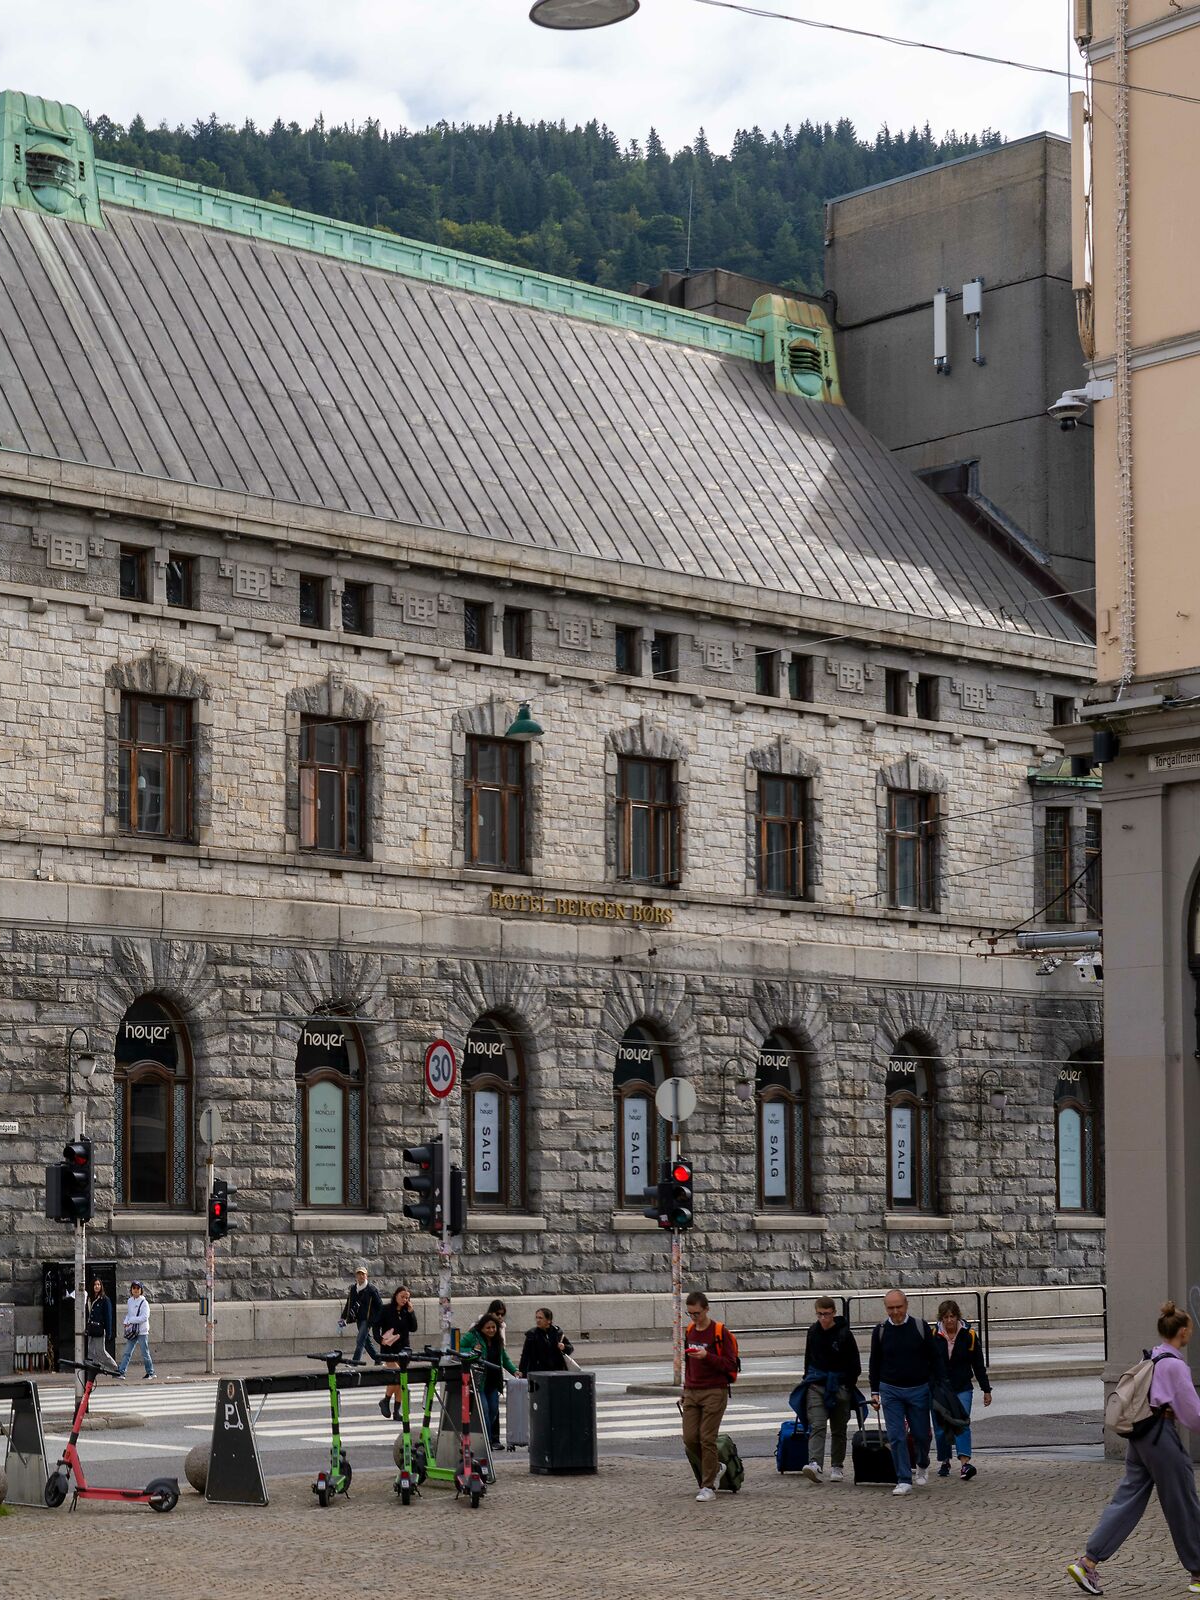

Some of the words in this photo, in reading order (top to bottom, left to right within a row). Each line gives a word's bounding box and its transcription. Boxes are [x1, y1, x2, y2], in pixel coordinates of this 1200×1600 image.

[490, 891, 550, 913] HOTEL
[555, 898, 627, 920] BERGEN
[631, 904, 673, 924] BØRS
[125, 1021, 169, 1044] høyer
[303, 1029, 345, 1051] høyer
[468, 1038, 506, 1059] høyer
[618, 1046, 654, 1064] høyer
[431, 1054, 451, 1083] 30
[1058, 1069, 1082, 1084] øyer
[482, 1126, 491, 1172] SALG
[631, 1131, 640, 1176] SALG
[770, 1135, 779, 1178] SALG
[897, 1139, 905, 1180] SALG
[224, 1403, 235, 1421] P
